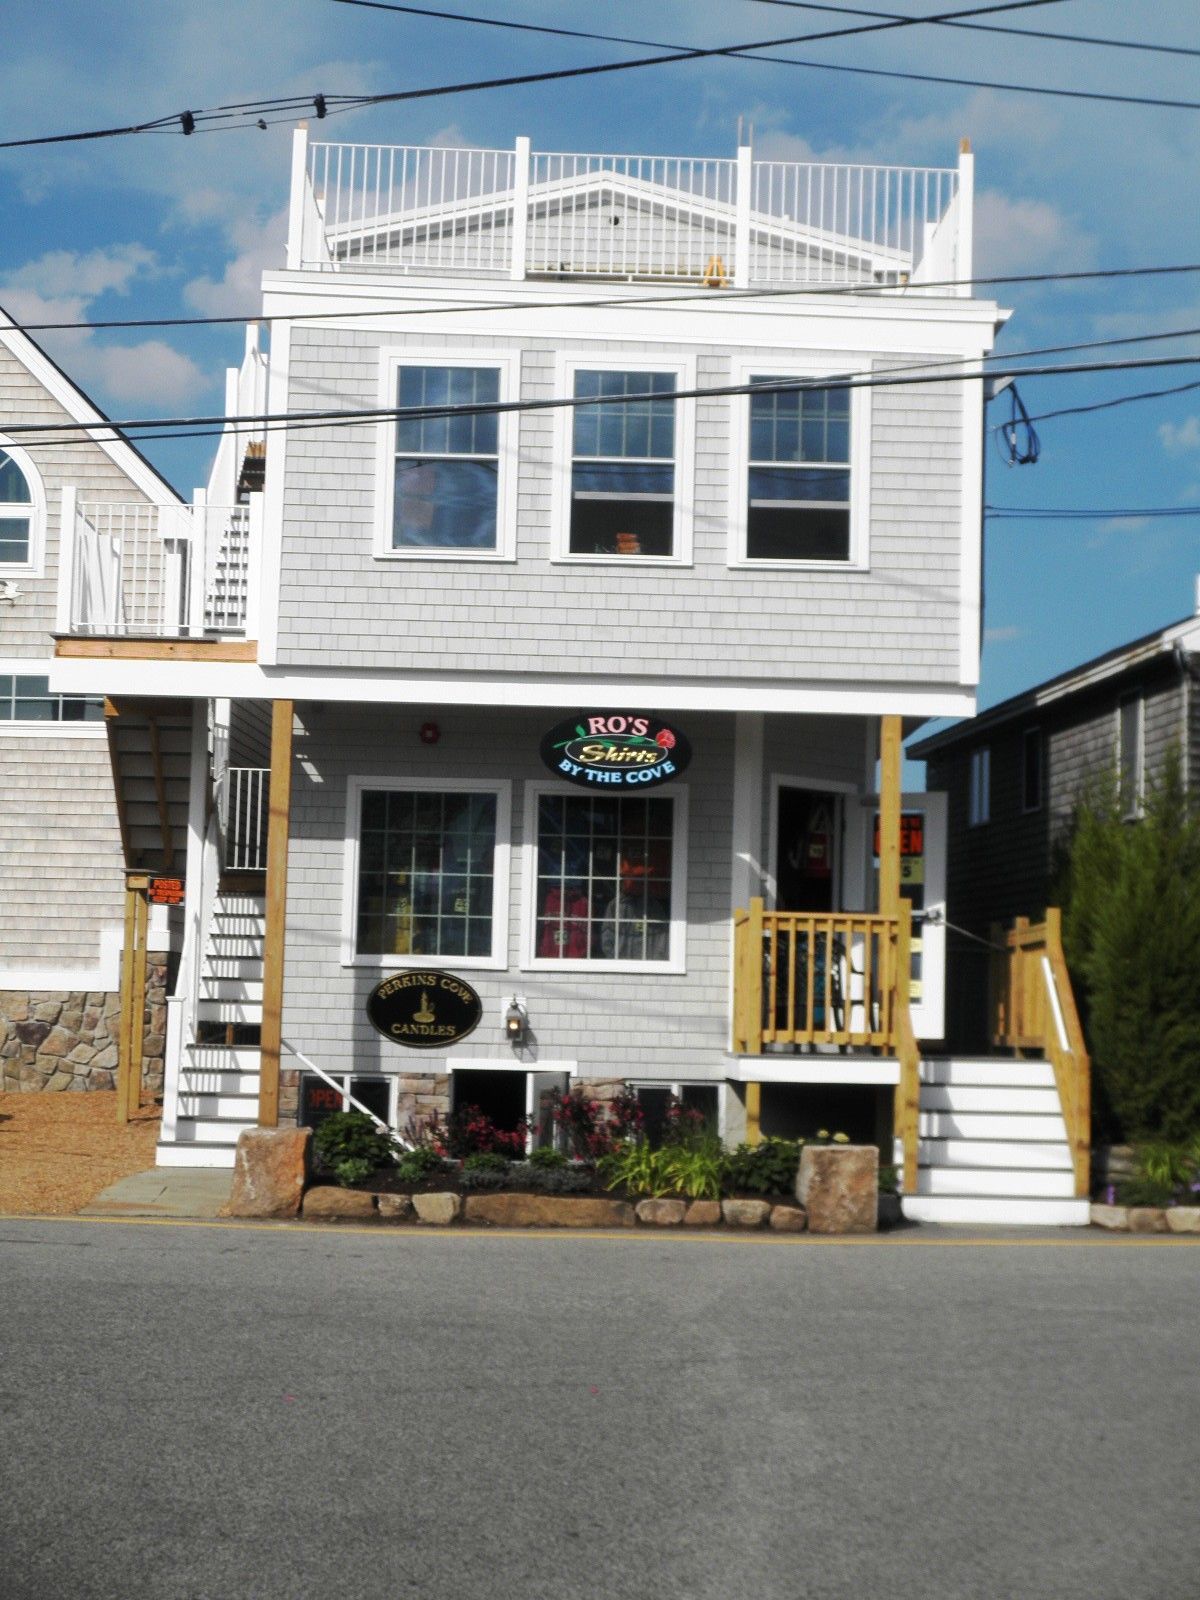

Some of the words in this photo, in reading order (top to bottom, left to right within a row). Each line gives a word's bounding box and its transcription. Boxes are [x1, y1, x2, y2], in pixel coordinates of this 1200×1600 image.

[588, 716, 649, 736] RO'S
[580, 744, 657, 763] Shirts
[559, 758, 583, 776] BY
[585, 769, 622, 783] THE
[625, 760, 675, 783] COVE
[378, 975, 437, 999] PERKINS
[440, 979, 473, 1004] COVE
[391, 1023, 456, 1036] CANDLES
